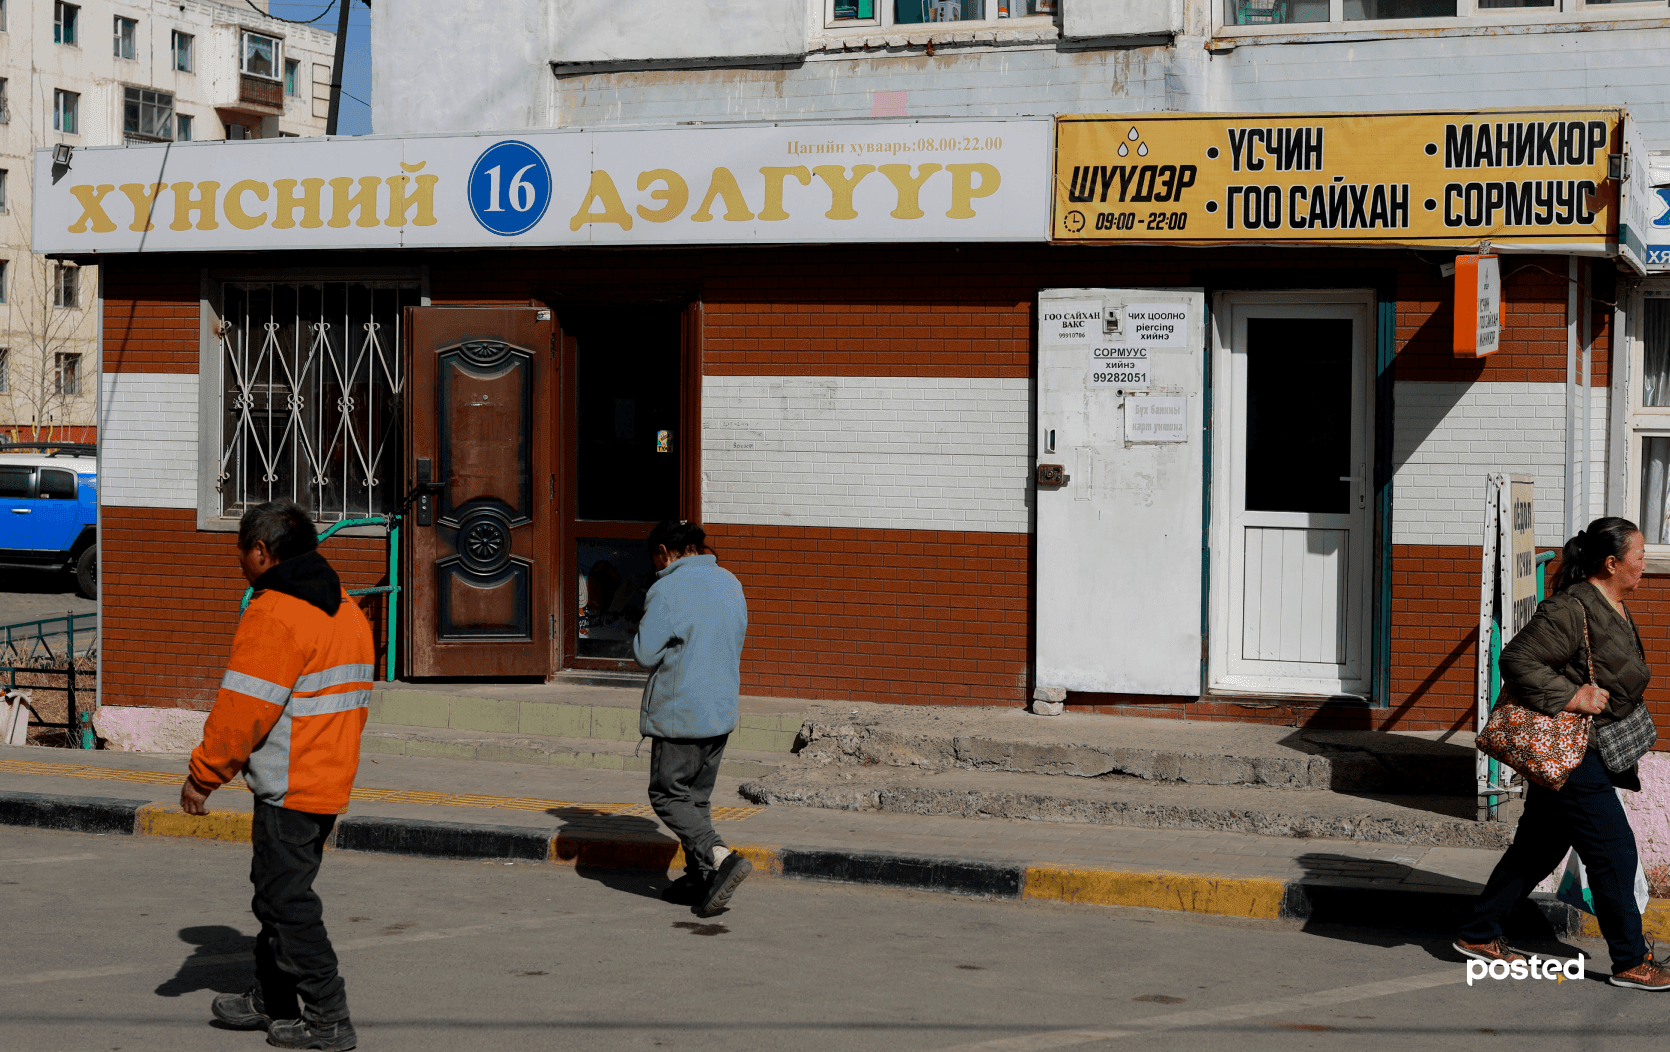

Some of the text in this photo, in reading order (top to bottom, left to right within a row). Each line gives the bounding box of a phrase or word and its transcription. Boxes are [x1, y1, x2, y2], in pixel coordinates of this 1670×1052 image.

[787, 140, 845, 157] Цагийн
[1227, 126, 1325, 172] ҮСЧИН
[1443, 120, 1607, 169] МАНИКЮР
[482, 163, 537, 213] 16
[1069, 165, 1198, 203] ШҮҮДЭР
[68, 161, 439, 234] ХҮНСНИЙ
[569, 161, 1002, 232] ДЭЛГҮҮР
[1225, 176, 1410, 230] ГОО САЙХАН
[1443, 180, 1597, 227] СОРМУУС
[1095, 212, 1136, 231] 09:00
[1147, 211, 1187, 230] 22:00
[1044, 311, 1101, 321] ГОО САЙХАН
[1062, 320, 1085, 329] ВАКС
[1128, 312, 1186, 321] ЧИХ ЦООЛНО
[1136, 323, 1174, 333] piercing
[1140, 332, 1170, 341] хийнэ
[1094, 348, 1147, 357] СОРМУУС
[1105, 361, 1135, 369] хийнэ
[1093, 372, 1147, 383] 99282051
